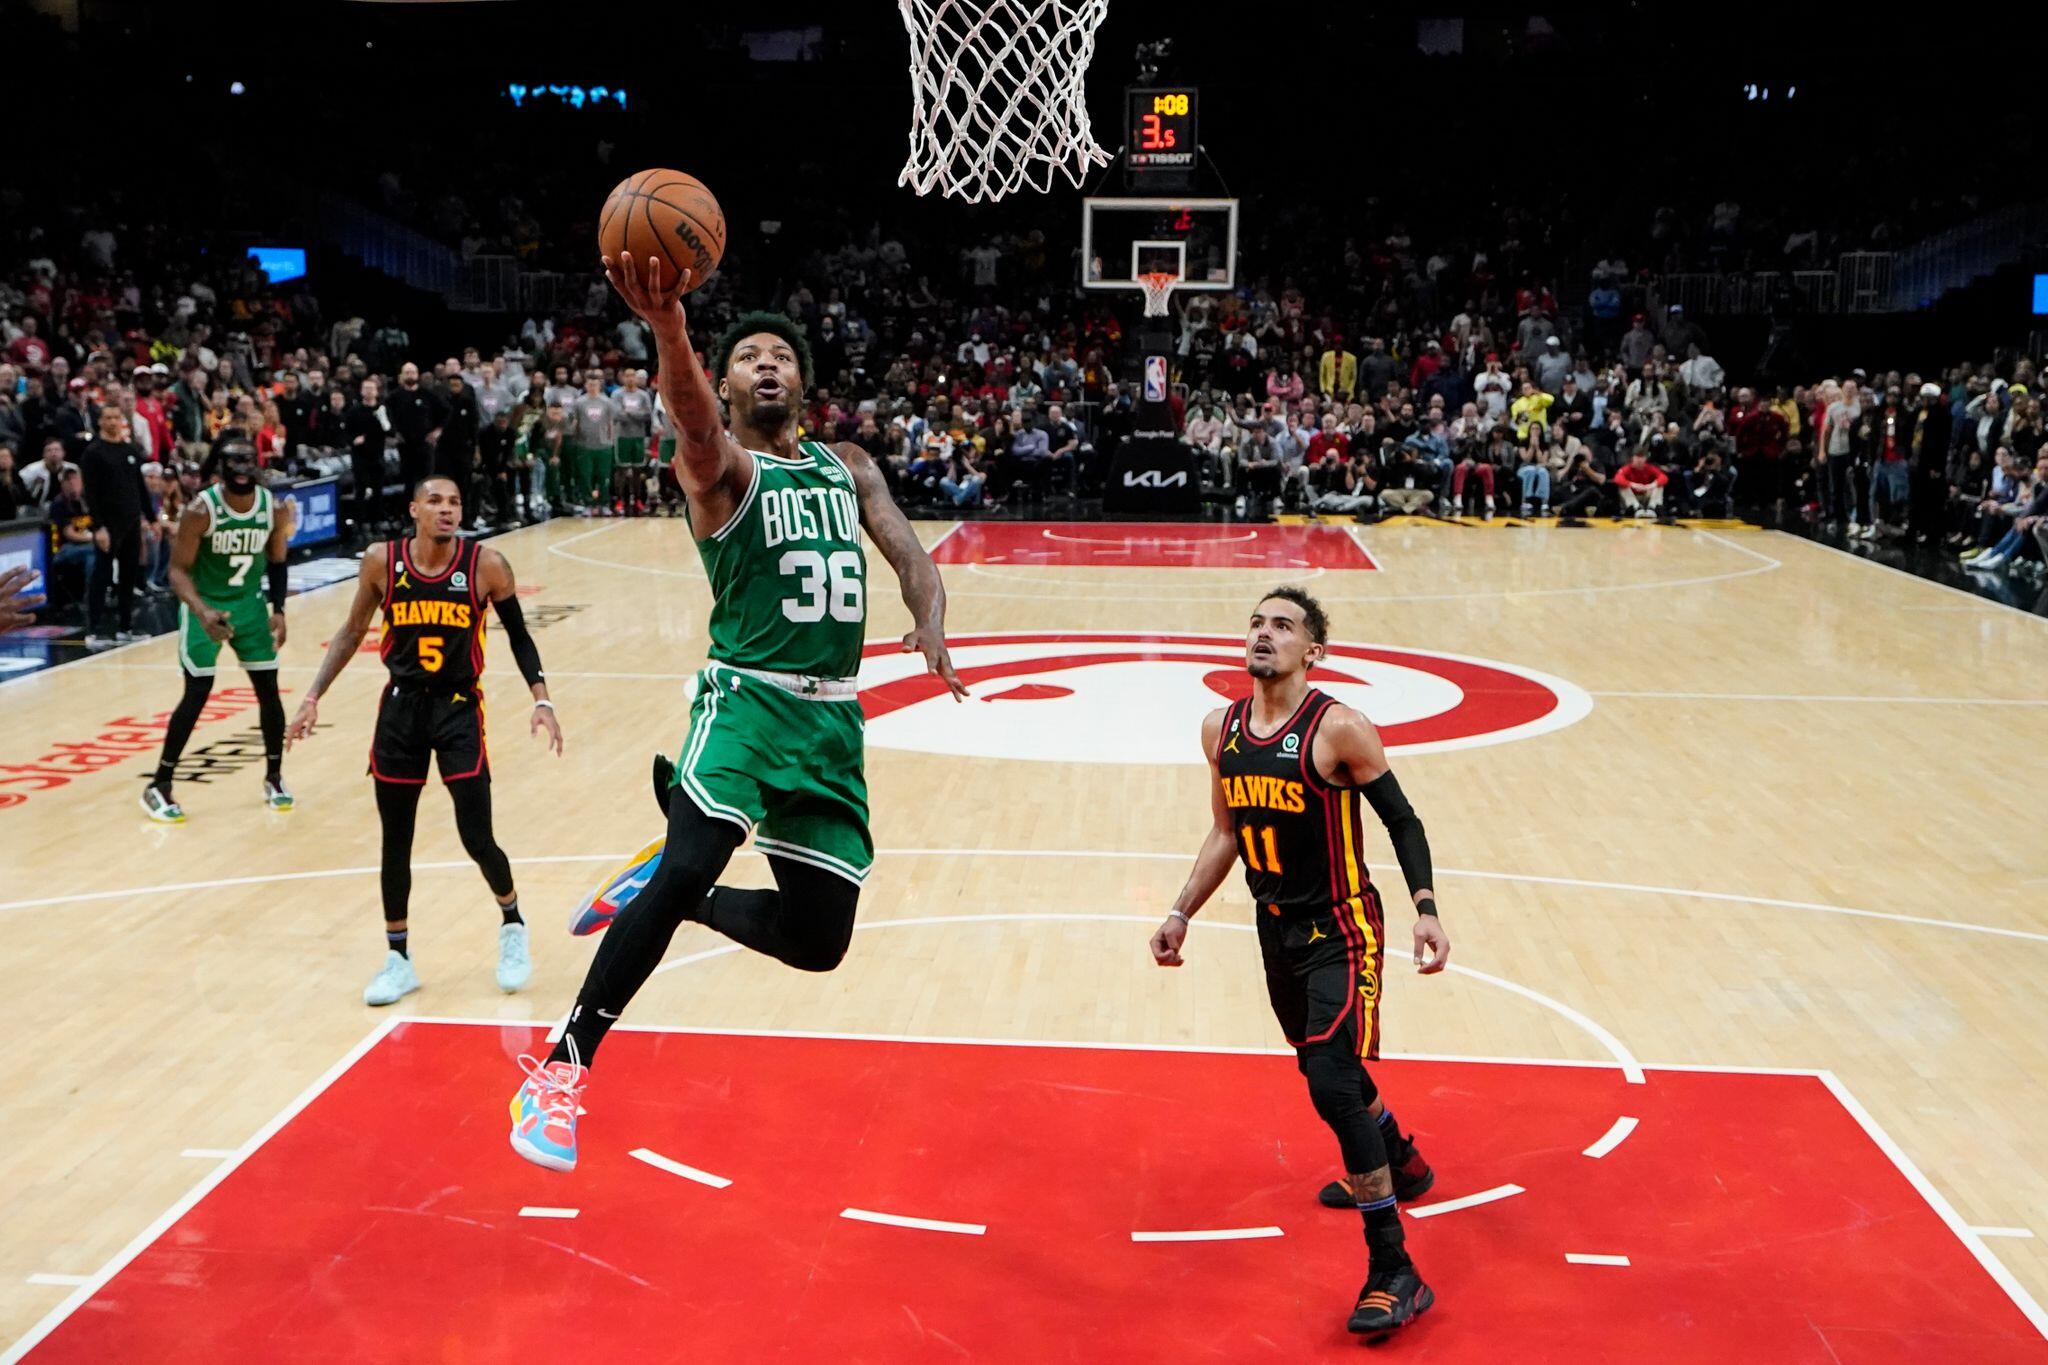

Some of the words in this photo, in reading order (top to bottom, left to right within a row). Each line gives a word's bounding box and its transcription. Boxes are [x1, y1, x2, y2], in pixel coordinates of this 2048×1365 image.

[1154, 94, 1188, 115] 1:08
[1148, 153, 1193, 164] TISSOT
[761, 487, 861, 548] BOSTON
[212, 528, 269, 554] BOSTON
[228, 555, 253, 586] 7
[779, 550, 864, 623] 36
[391, 601, 471, 628] HAWKS
[418, 637, 444, 673] 5
[1221, 775, 1305, 813] HAWKS
[1241, 825, 1282, 875] 11
